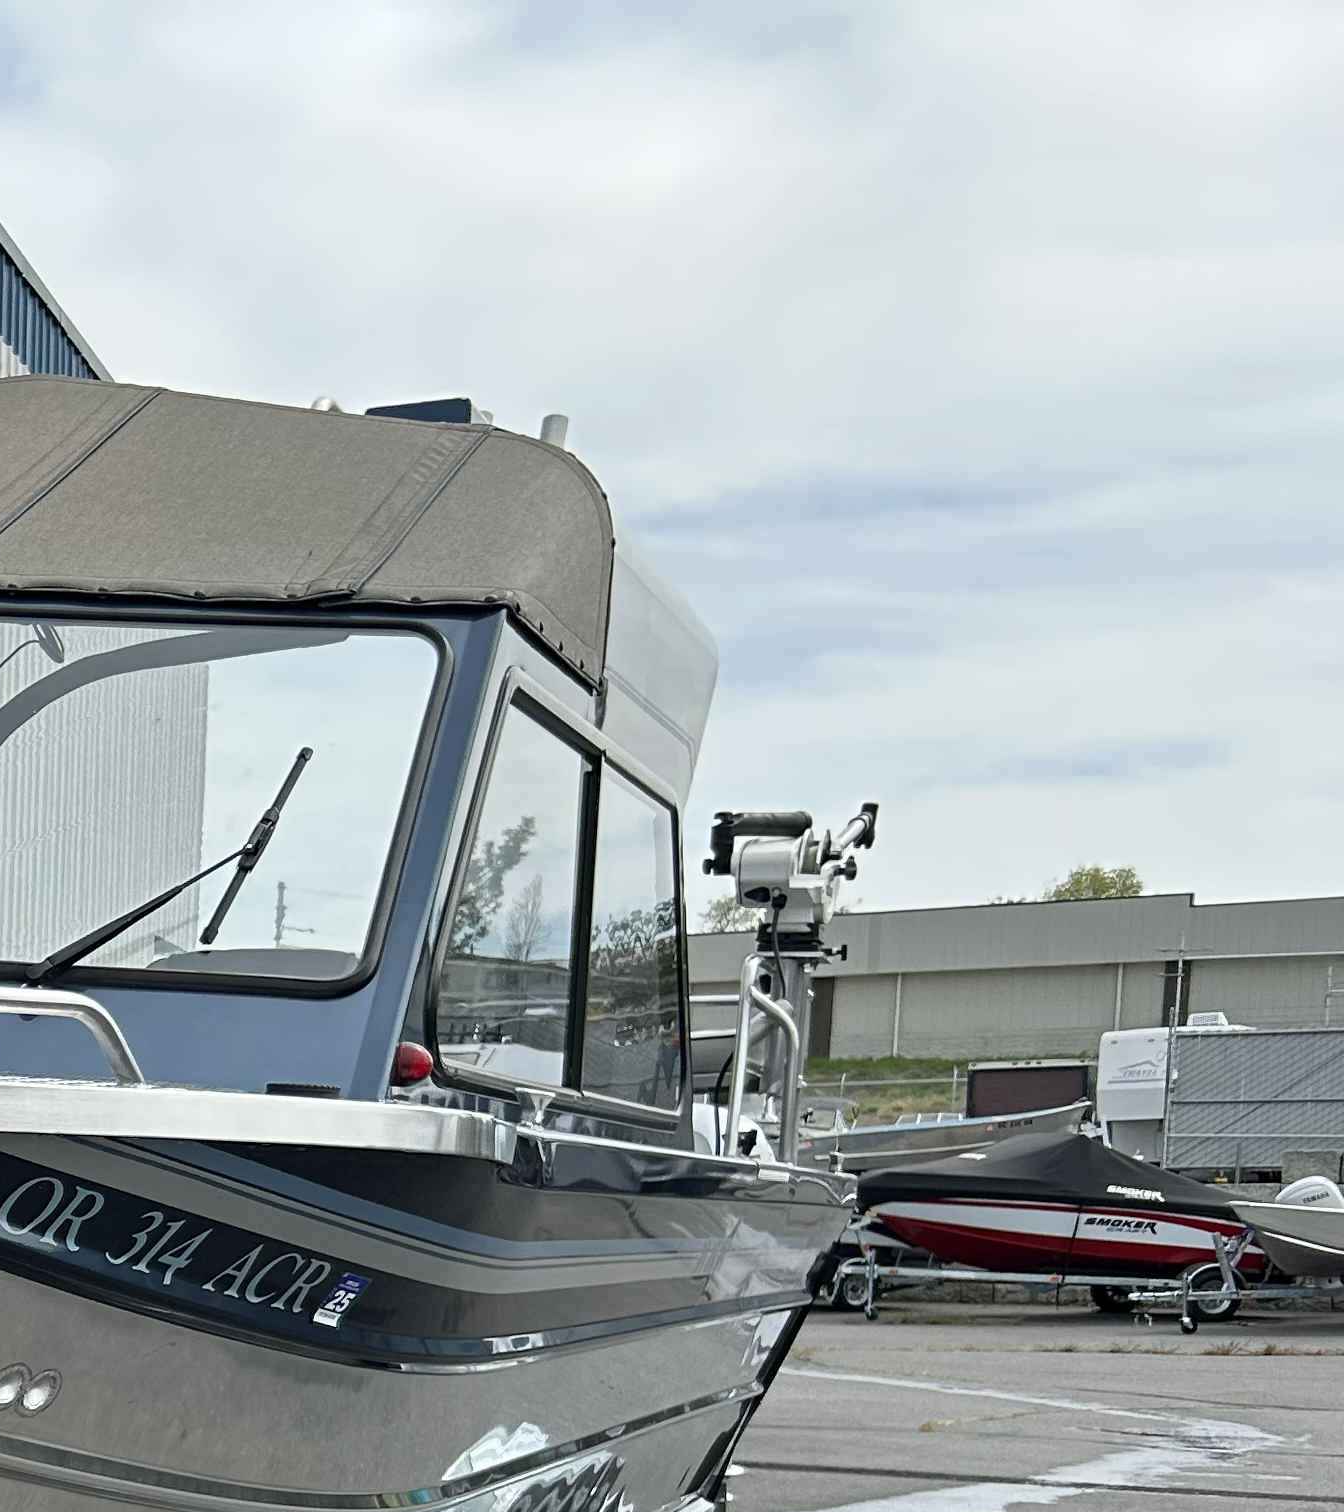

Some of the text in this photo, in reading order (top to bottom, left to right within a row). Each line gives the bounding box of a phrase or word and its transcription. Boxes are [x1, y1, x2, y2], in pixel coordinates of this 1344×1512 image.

[1083, 1217, 1158, 1236] SMOKER
[105, 1210, 213, 1286] 314
[201, 1243, 332, 1314] ACR
[324, 1289, 357, 1313] 25
